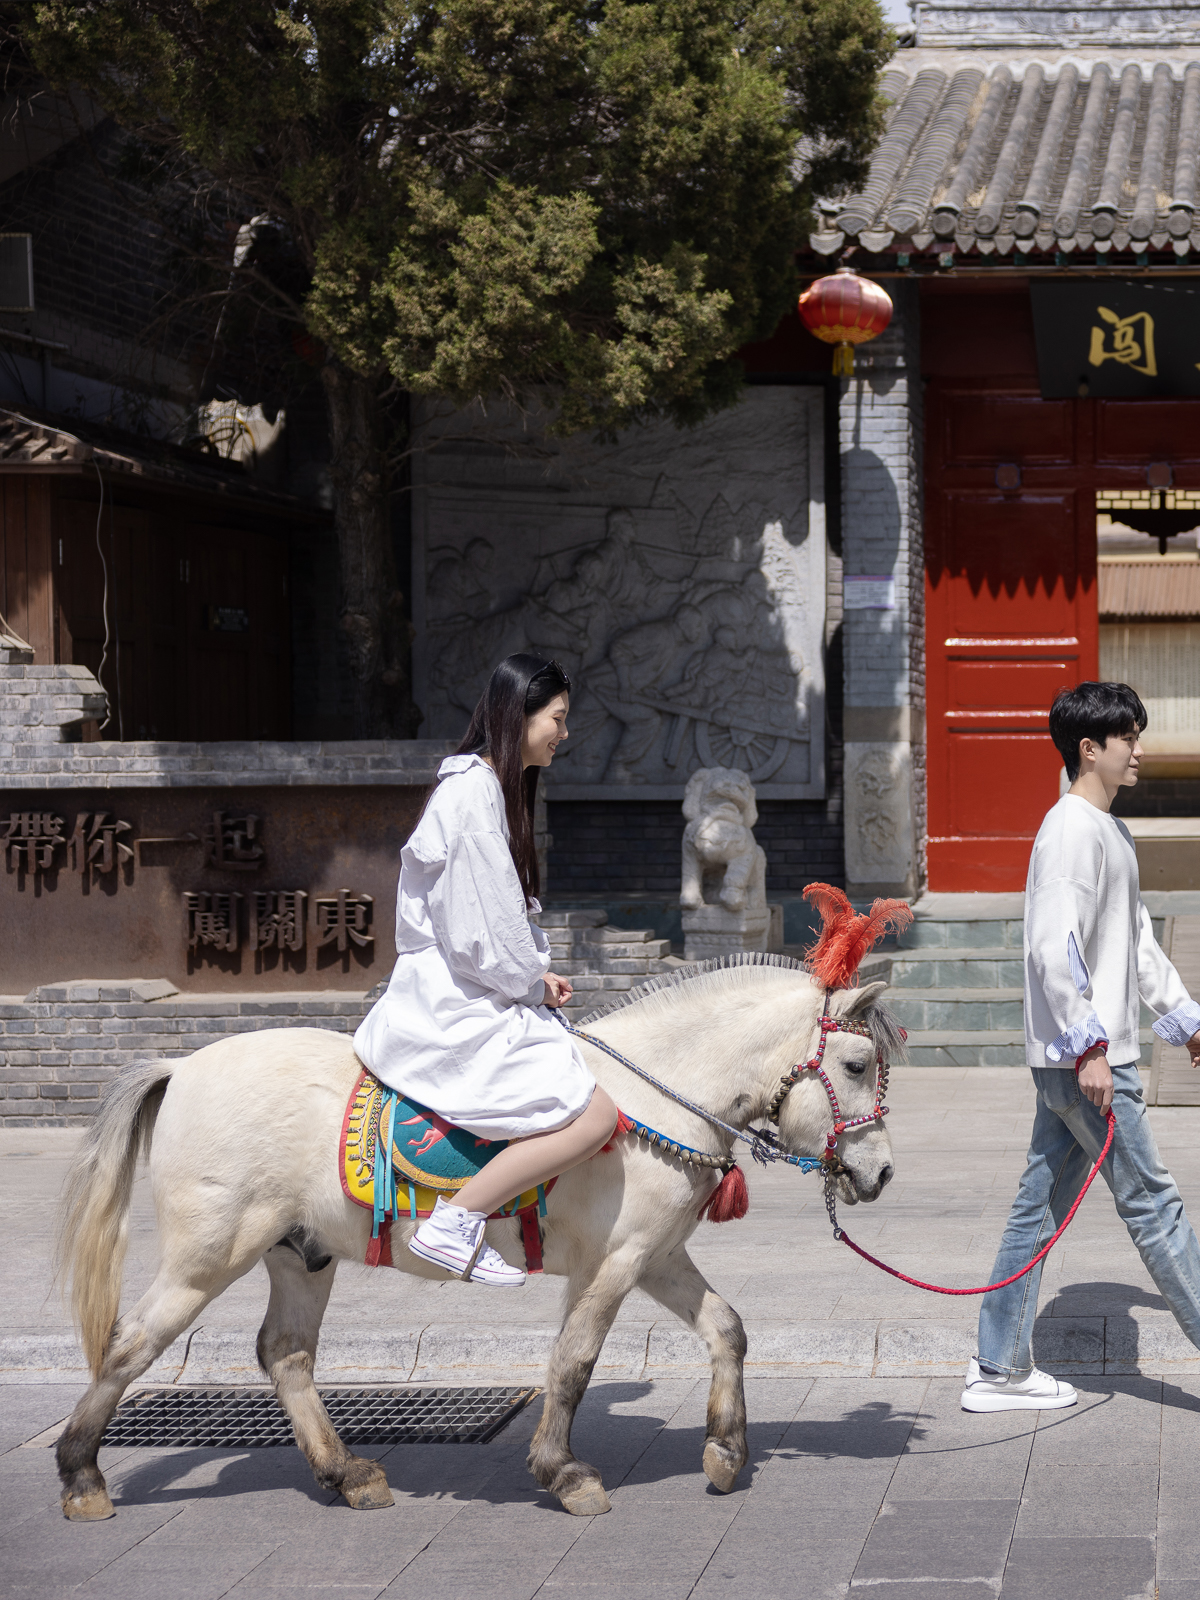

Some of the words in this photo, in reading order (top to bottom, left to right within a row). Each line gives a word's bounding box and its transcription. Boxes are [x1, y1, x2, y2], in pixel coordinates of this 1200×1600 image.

[0, 810, 265, 872] 帶你一起
[182, 888, 375, 951] 闖關東
